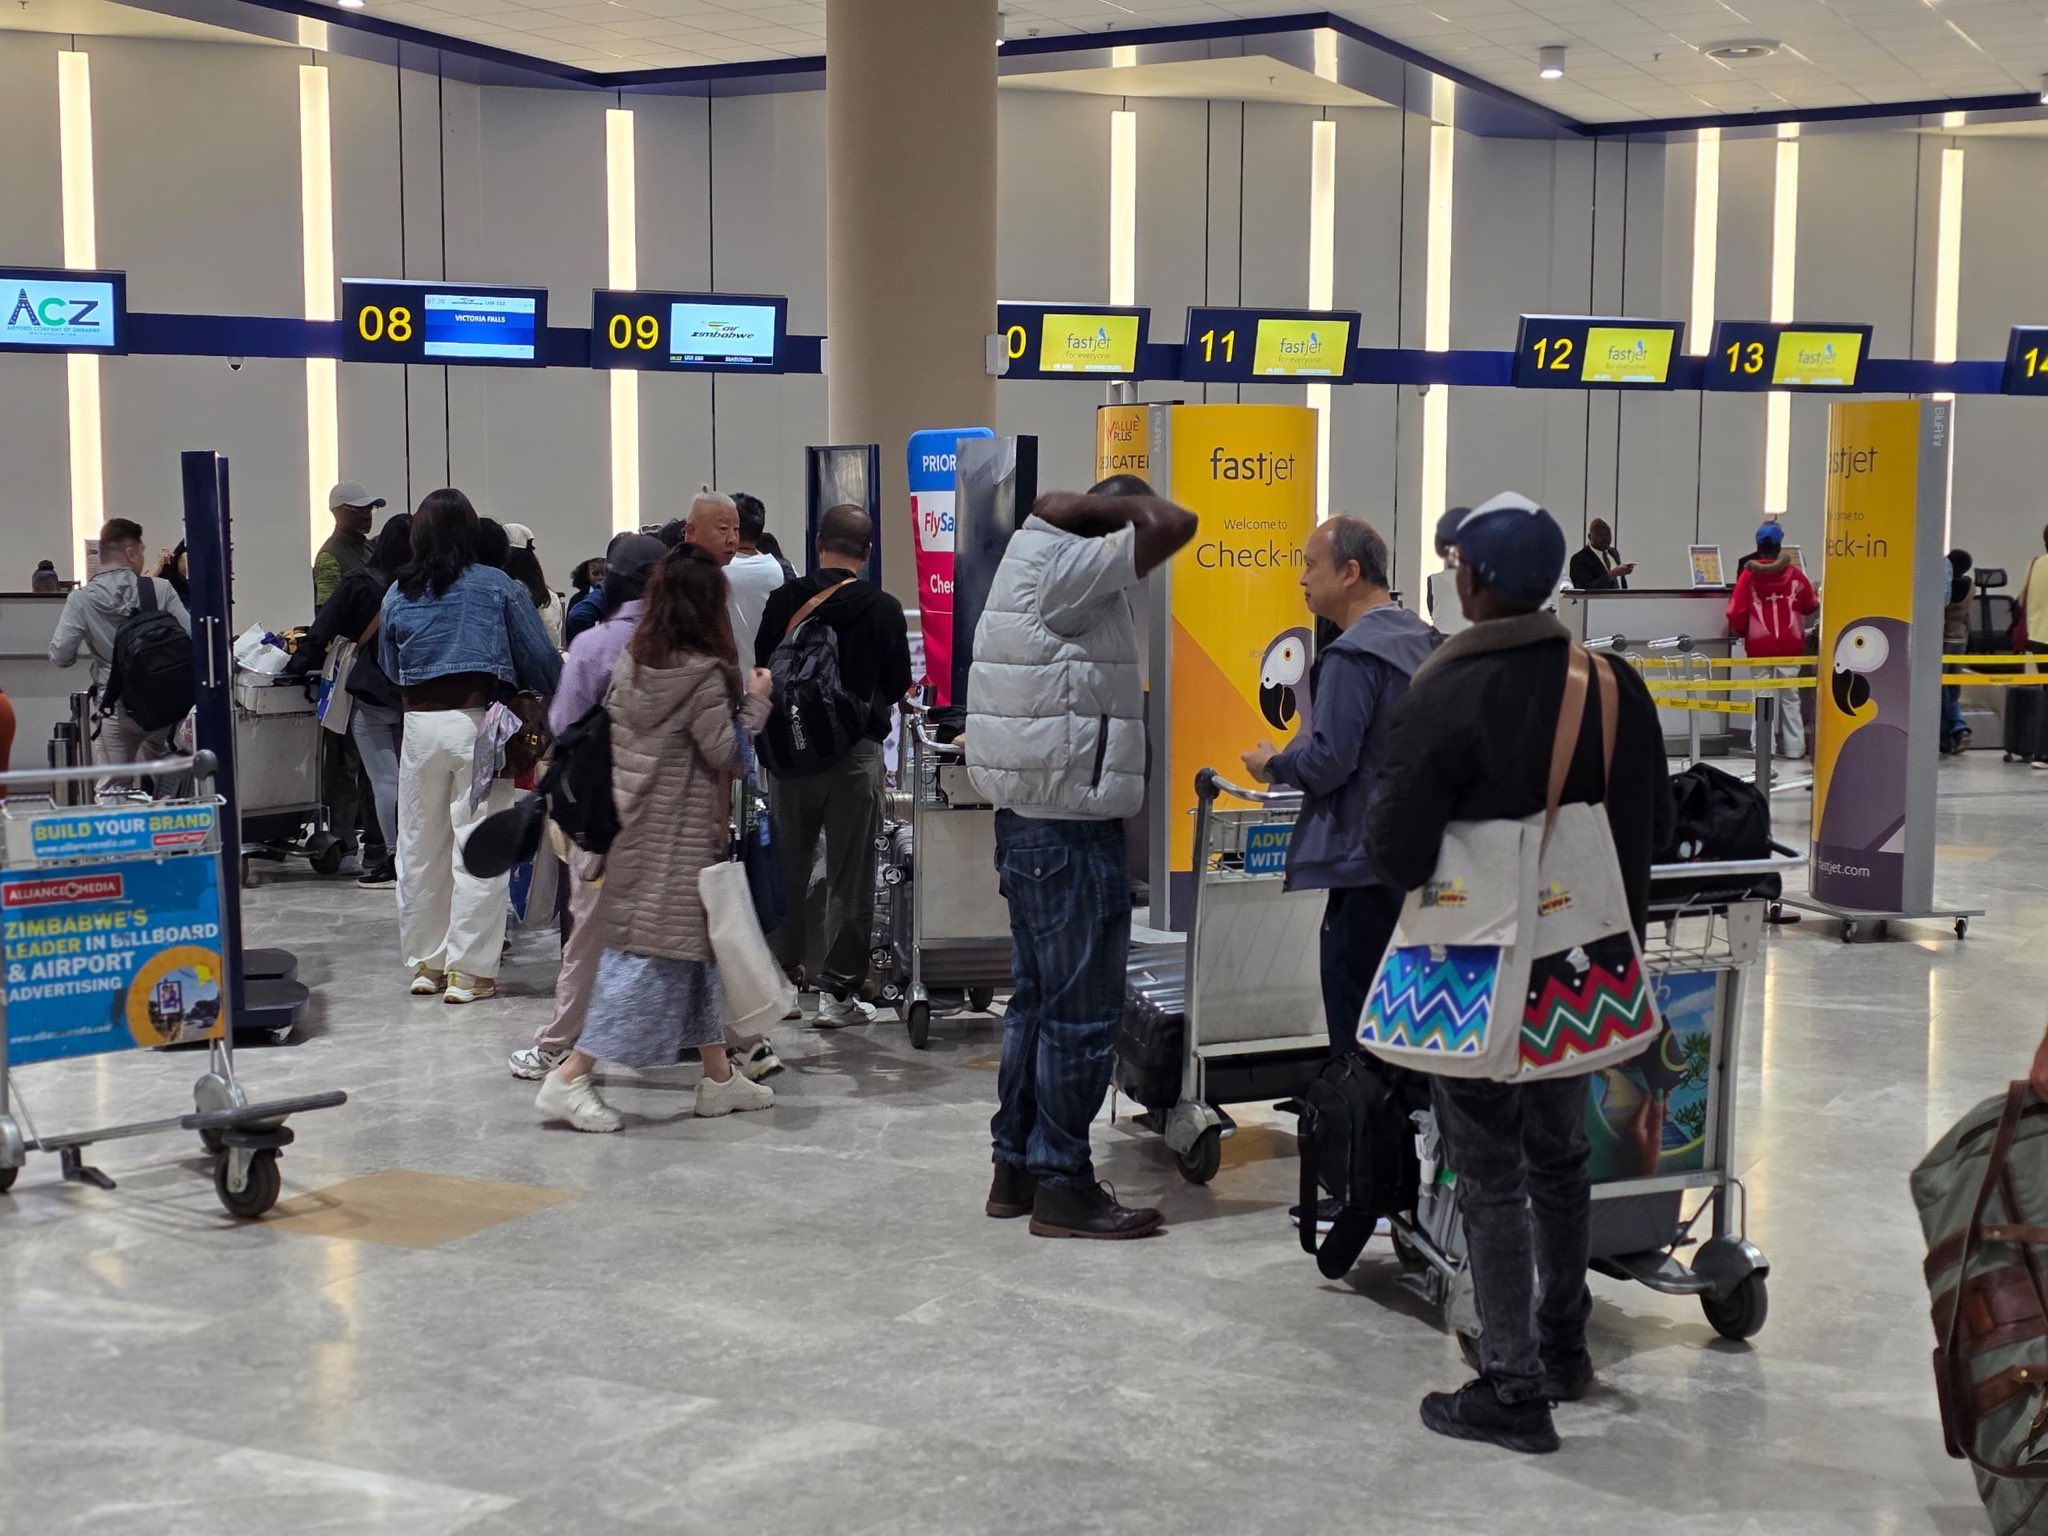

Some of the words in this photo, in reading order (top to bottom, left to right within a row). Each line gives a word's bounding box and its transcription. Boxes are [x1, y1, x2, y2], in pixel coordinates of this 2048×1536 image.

[8, 288, 100, 326] ACZ
[455, 314, 486, 322] VICTORIA
[487, 315, 506, 323] FALLS
[358, 305, 412, 342] 08
[608, 314, 659, 350] 09
[691, 331, 755, 339] zimbabwe
[1067, 333, 1112, 351] fastjet
[1200, 330, 1236, 363] 11
[1280, 338, 1323, 355] fastjet
[1533, 338, 1574, 370] 12
[1608, 346, 1648, 363] fastjet
[1726, 342, 1764, 374] 13
[1798, 350, 1837, 366] fastjet
[1113, 431, 1132, 441] PLUS
[1210, 446, 1296, 486] fastjet
[1223, 518, 1276, 530] Welcome
[1278, 520, 1288, 530] to
[1196, 540, 1303, 568] Check-in
[35, 822, 91, 841] BUILD
[94, 818, 145, 835] YOUR
[149, 813, 212, 831] BRAND
[9, 885, 65, 901] ALLIANCE
[77, 881, 116, 894] MEDIA
[4, 909, 148, 940] ZIMBABWE'S
[6, 937, 81, 960] LEADER
[86, 935, 106, 951] IN
[110, 923, 219, 948] BILLBOARD
[8, 963, 26, 982] &
[30, 951, 135, 980] AIRPORT
[8, 976, 122, 1002] ADVERTISING
